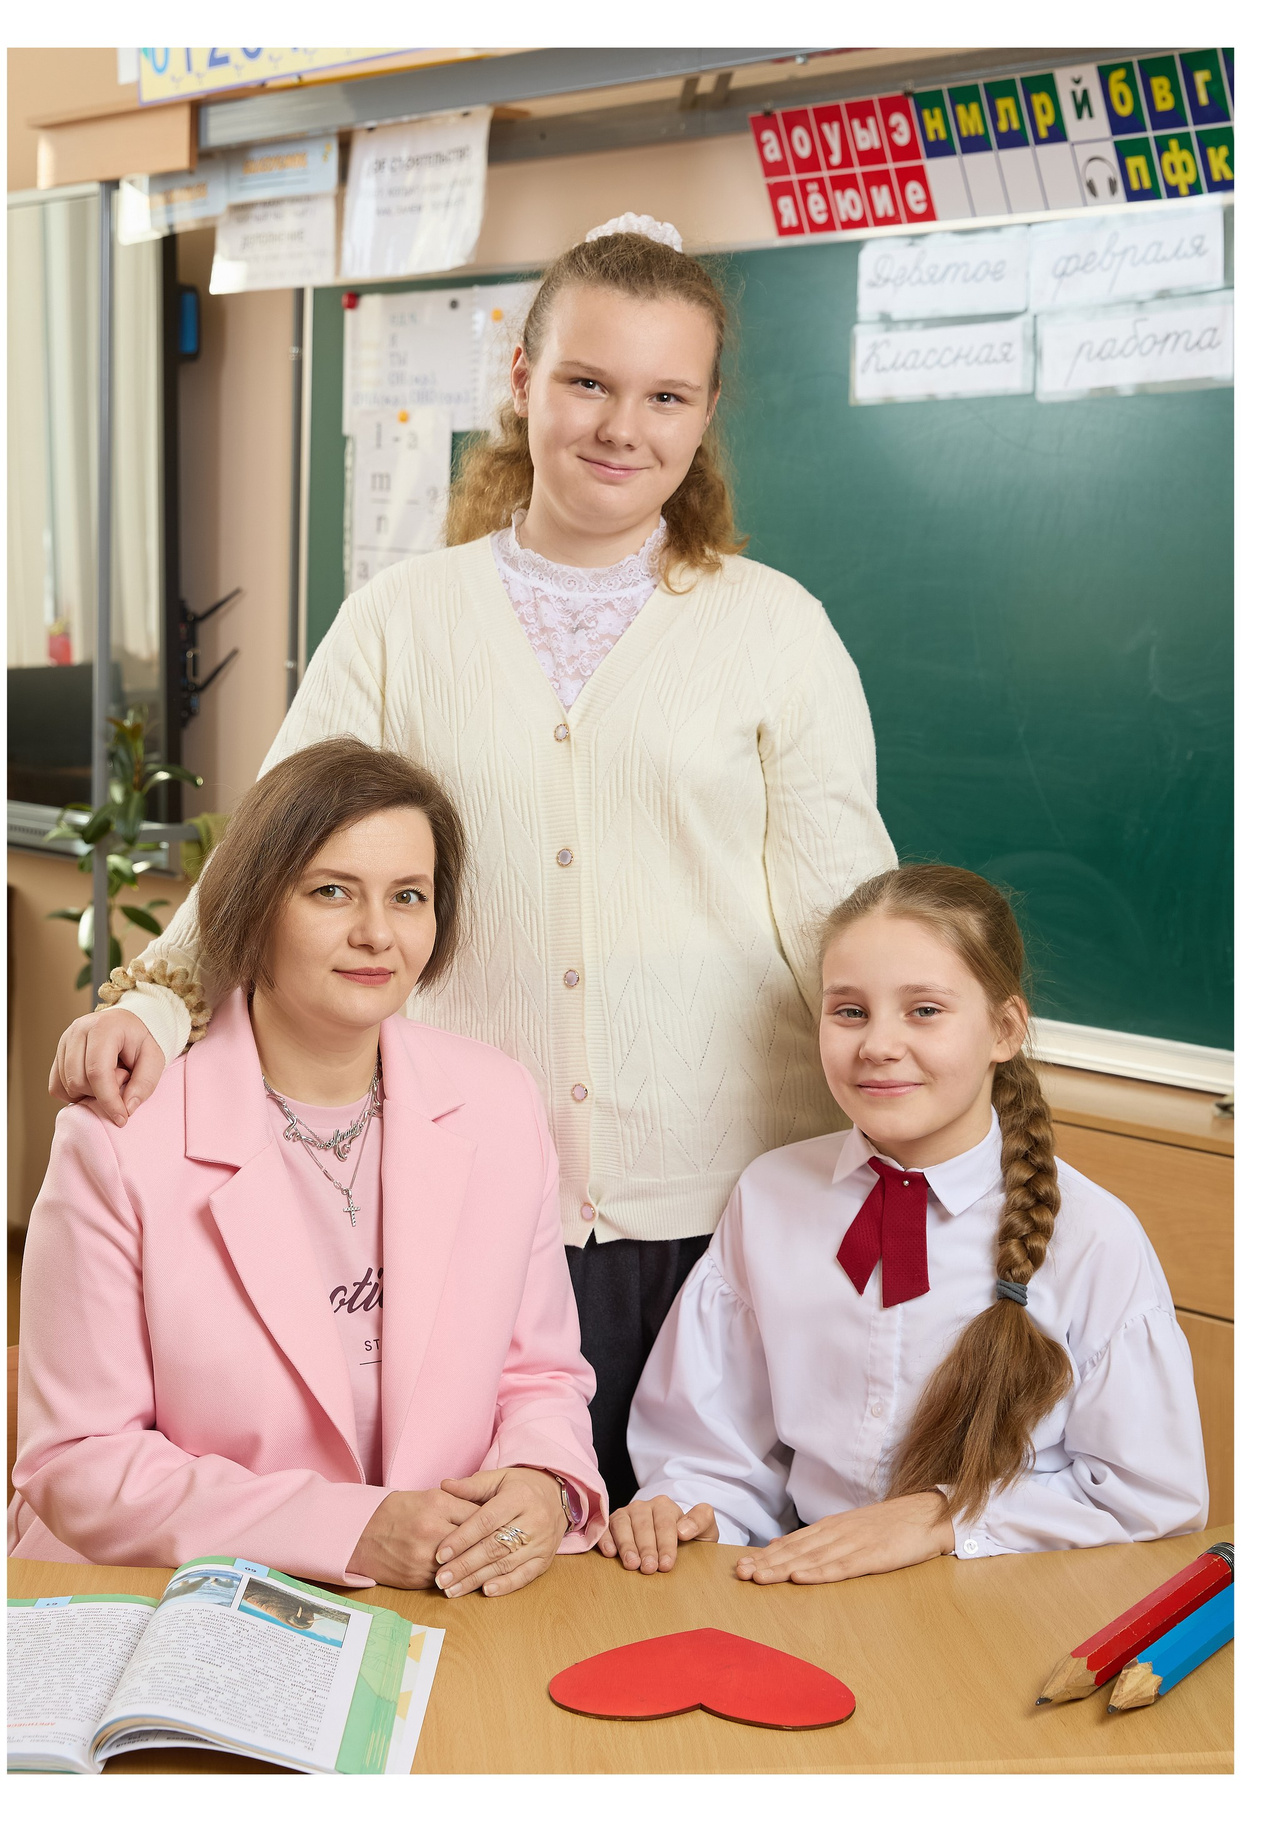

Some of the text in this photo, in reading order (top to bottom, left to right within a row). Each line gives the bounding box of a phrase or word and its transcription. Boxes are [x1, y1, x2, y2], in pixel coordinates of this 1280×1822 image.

[1050, 230, 1209, 303] февраля
[860, 338, 1017, 375] Классная
[1064, 318, 1222, 387] работа
